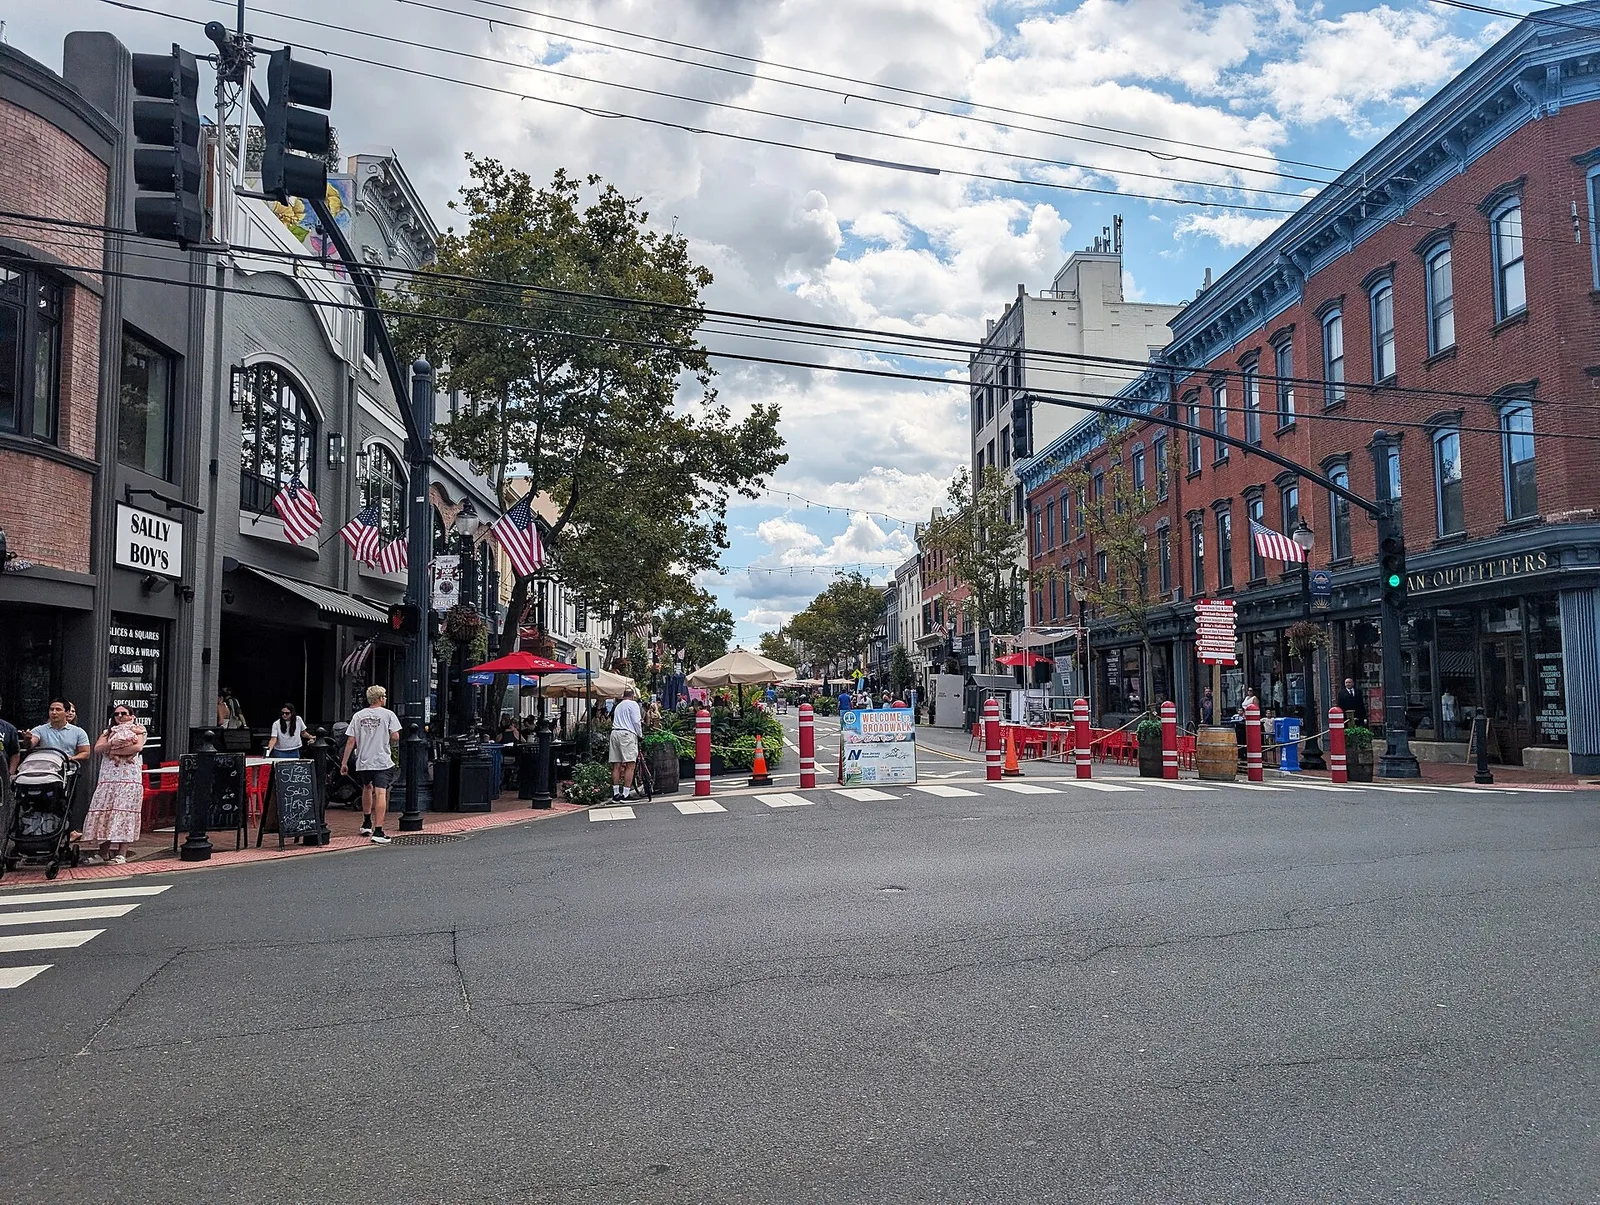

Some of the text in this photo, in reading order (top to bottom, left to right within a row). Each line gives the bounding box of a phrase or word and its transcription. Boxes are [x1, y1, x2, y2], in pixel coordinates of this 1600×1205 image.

[130, 513, 171, 542] SALLY
[130, 542, 169, 570] BOY'S
[1406, 551, 1548, 592] AN OUTFITTERS
[129, 629, 134, 638] &
[134, 630, 160, 640] SQUARES
[109, 645, 160, 658] OT SUBS & WRAPS
[121, 663, 143, 674] SALADS
[111, 681, 153, 692] FRIES & WINGS
[862, 713, 901, 723] WELCOME
[863, 722, 912, 733] BROADWALK
